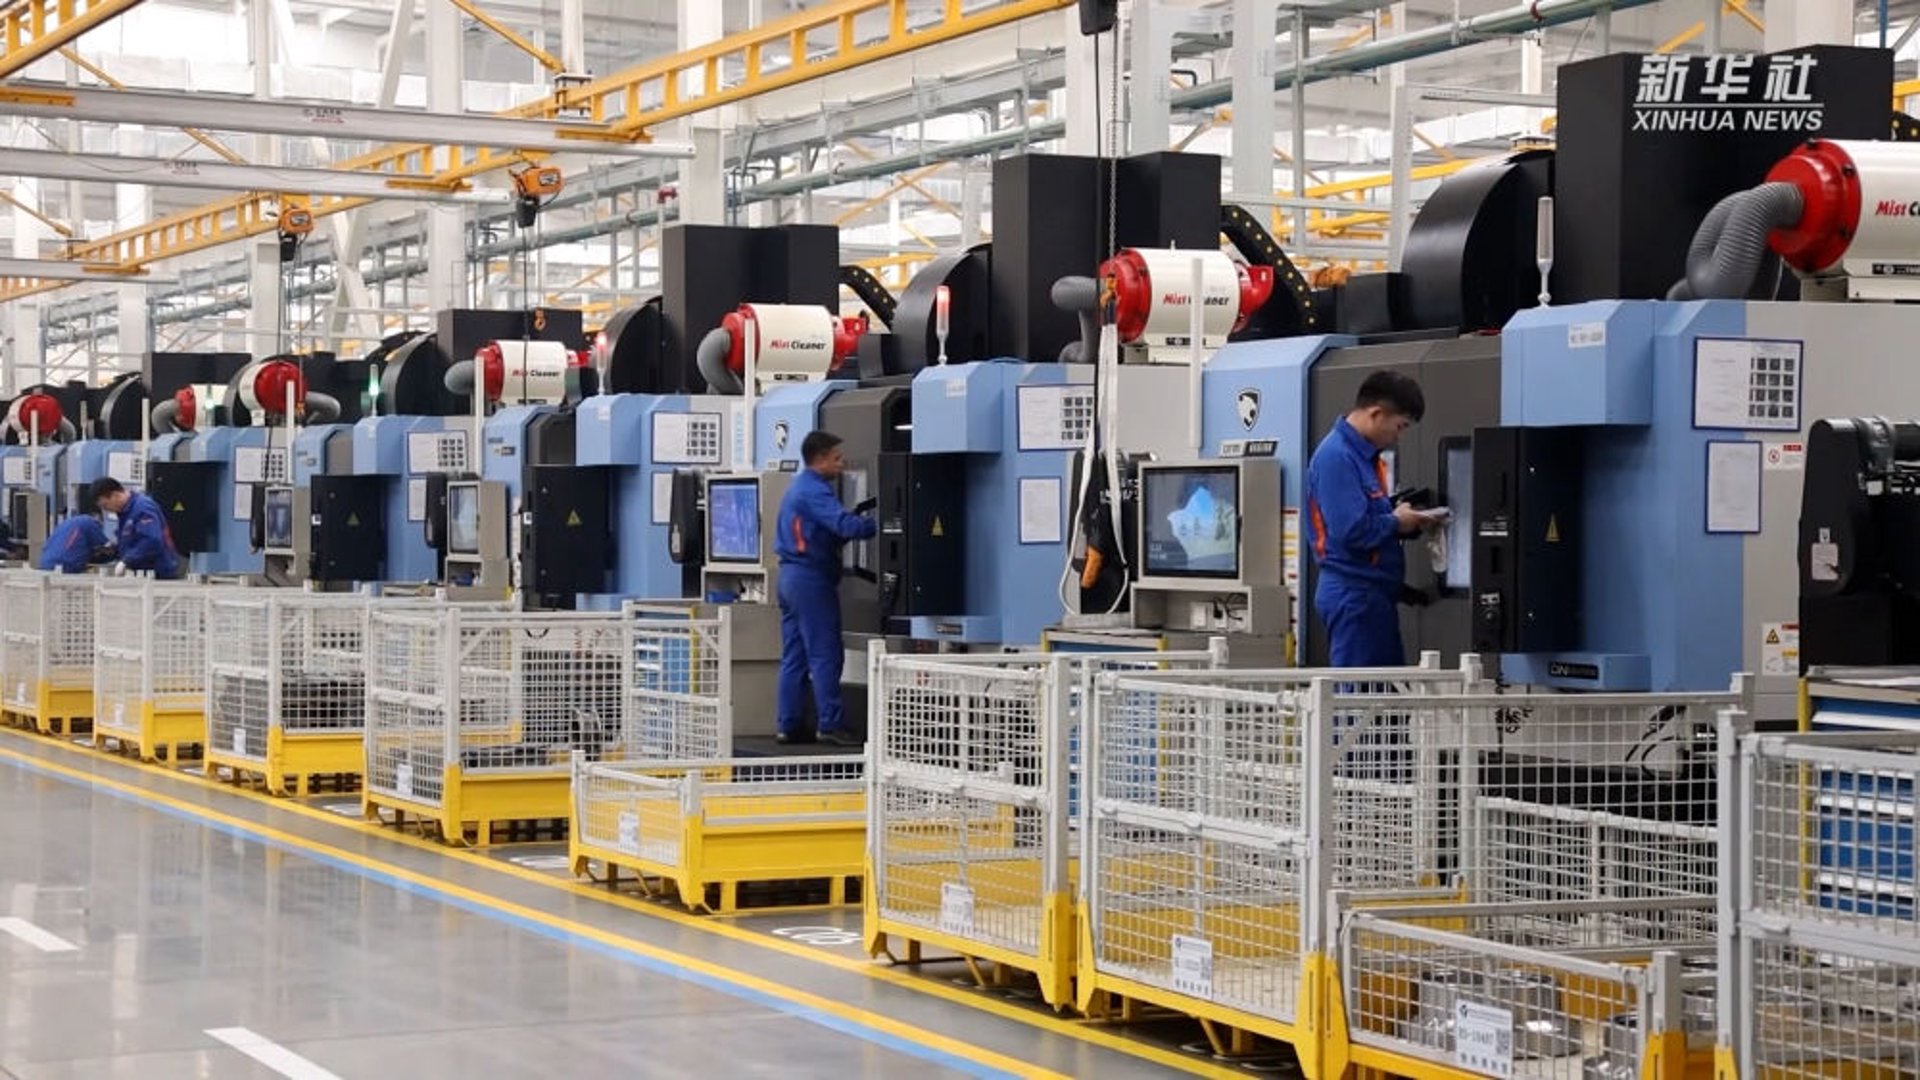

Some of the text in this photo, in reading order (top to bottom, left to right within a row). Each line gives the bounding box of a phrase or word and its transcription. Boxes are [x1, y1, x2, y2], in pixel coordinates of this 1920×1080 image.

[1876, 200, 1907, 216] Mist
[1163, 293, 1187, 305] Mist
[790, 340, 826, 350] Cleaner
